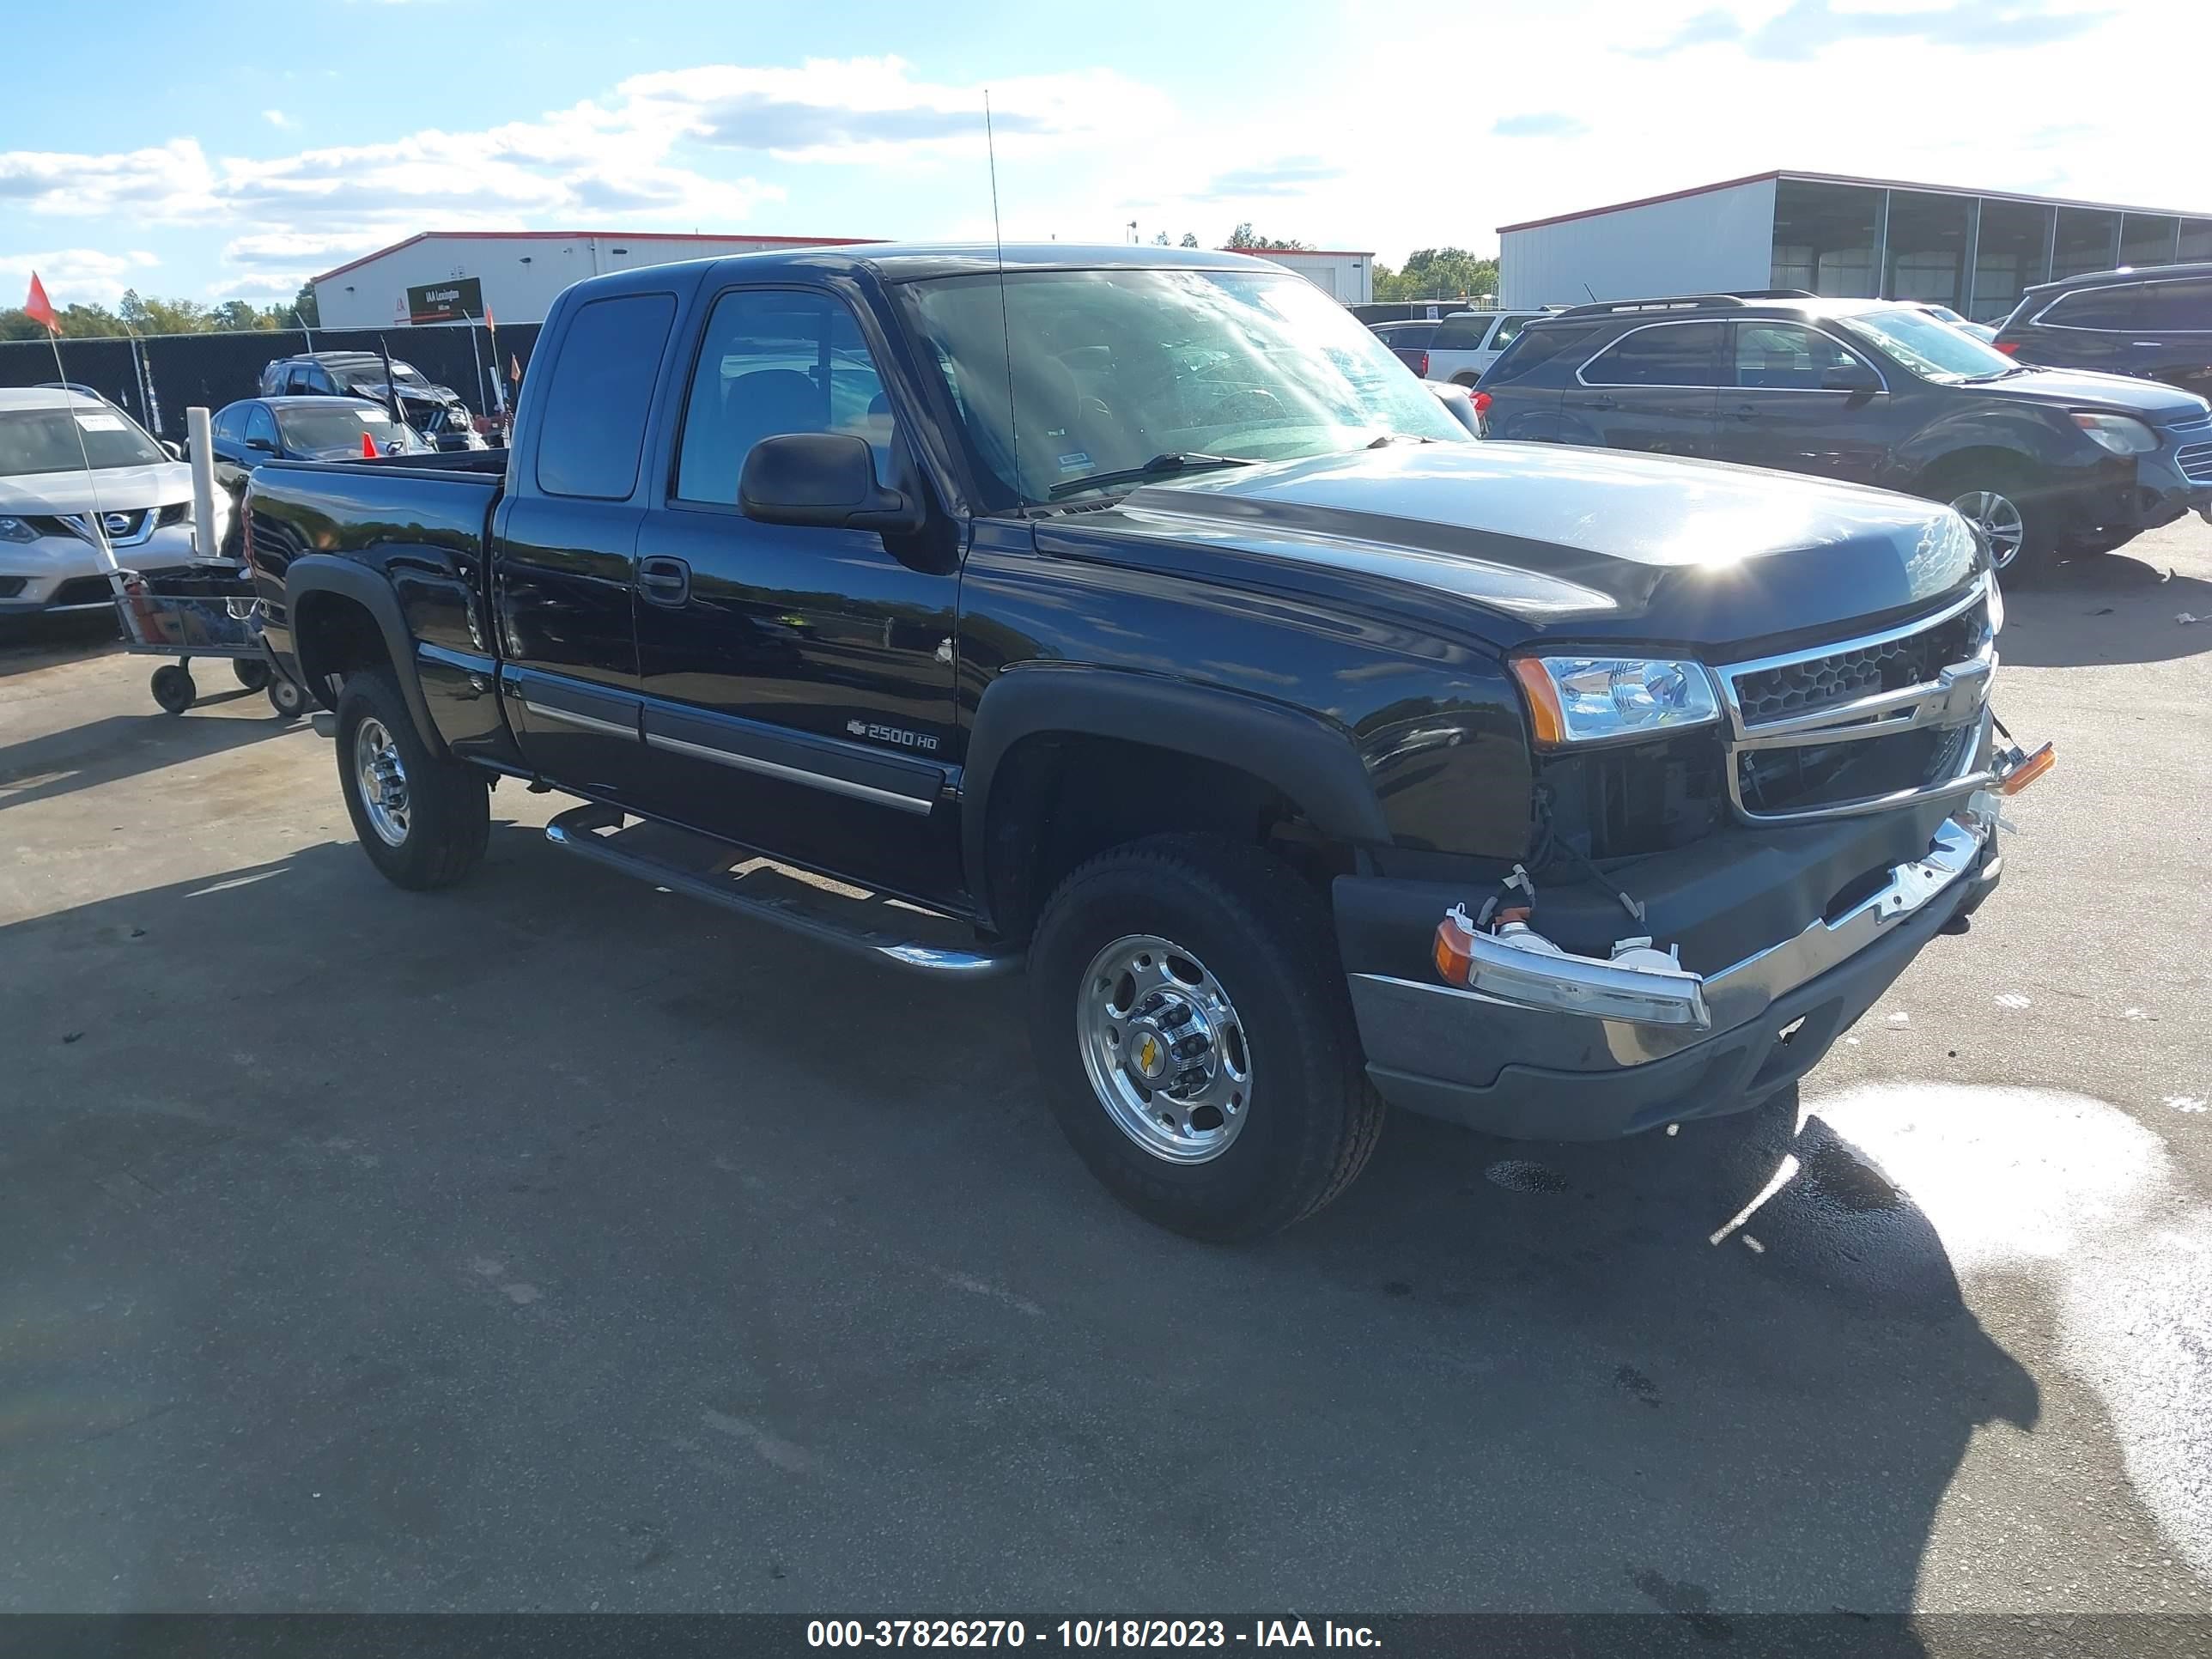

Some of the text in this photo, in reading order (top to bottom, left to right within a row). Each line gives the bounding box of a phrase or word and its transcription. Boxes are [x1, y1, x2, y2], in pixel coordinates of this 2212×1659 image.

[426, 289, 436, 302] IAA
[868, 725, 938, 749] 2500 HD
